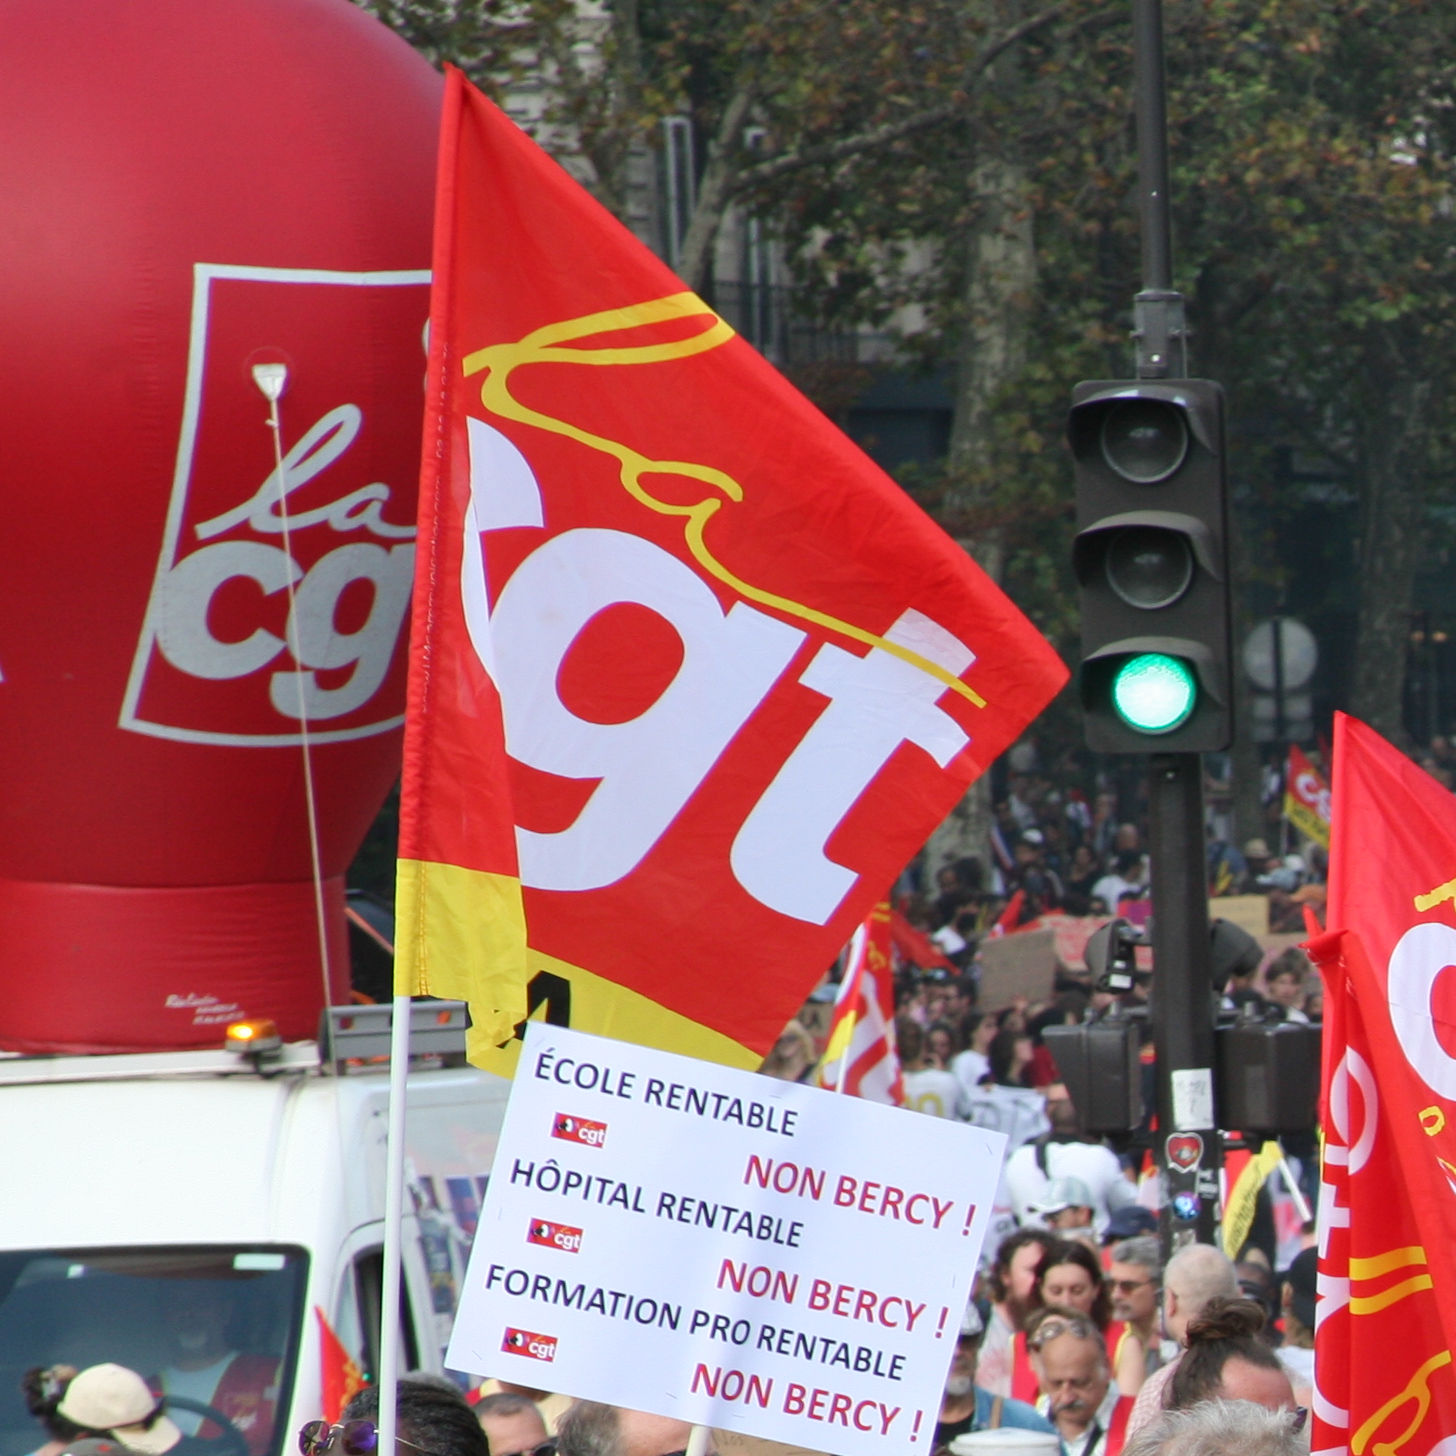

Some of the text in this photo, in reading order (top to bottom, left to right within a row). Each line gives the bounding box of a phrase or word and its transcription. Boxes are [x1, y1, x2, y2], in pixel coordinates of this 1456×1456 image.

[535, 1047, 798, 1137] ÉCOLE RENTABLE
[510, 1157, 804, 1248] HÔPITAL RENTABLE
[743, 1154, 977, 1237] NON BERCY !
[484, 1263, 907, 1382] FORMATION PRO RENTABLE
[716, 1257, 950, 1339] NON BERCY !
[689, 1362, 924, 1443] NON BERCY !
